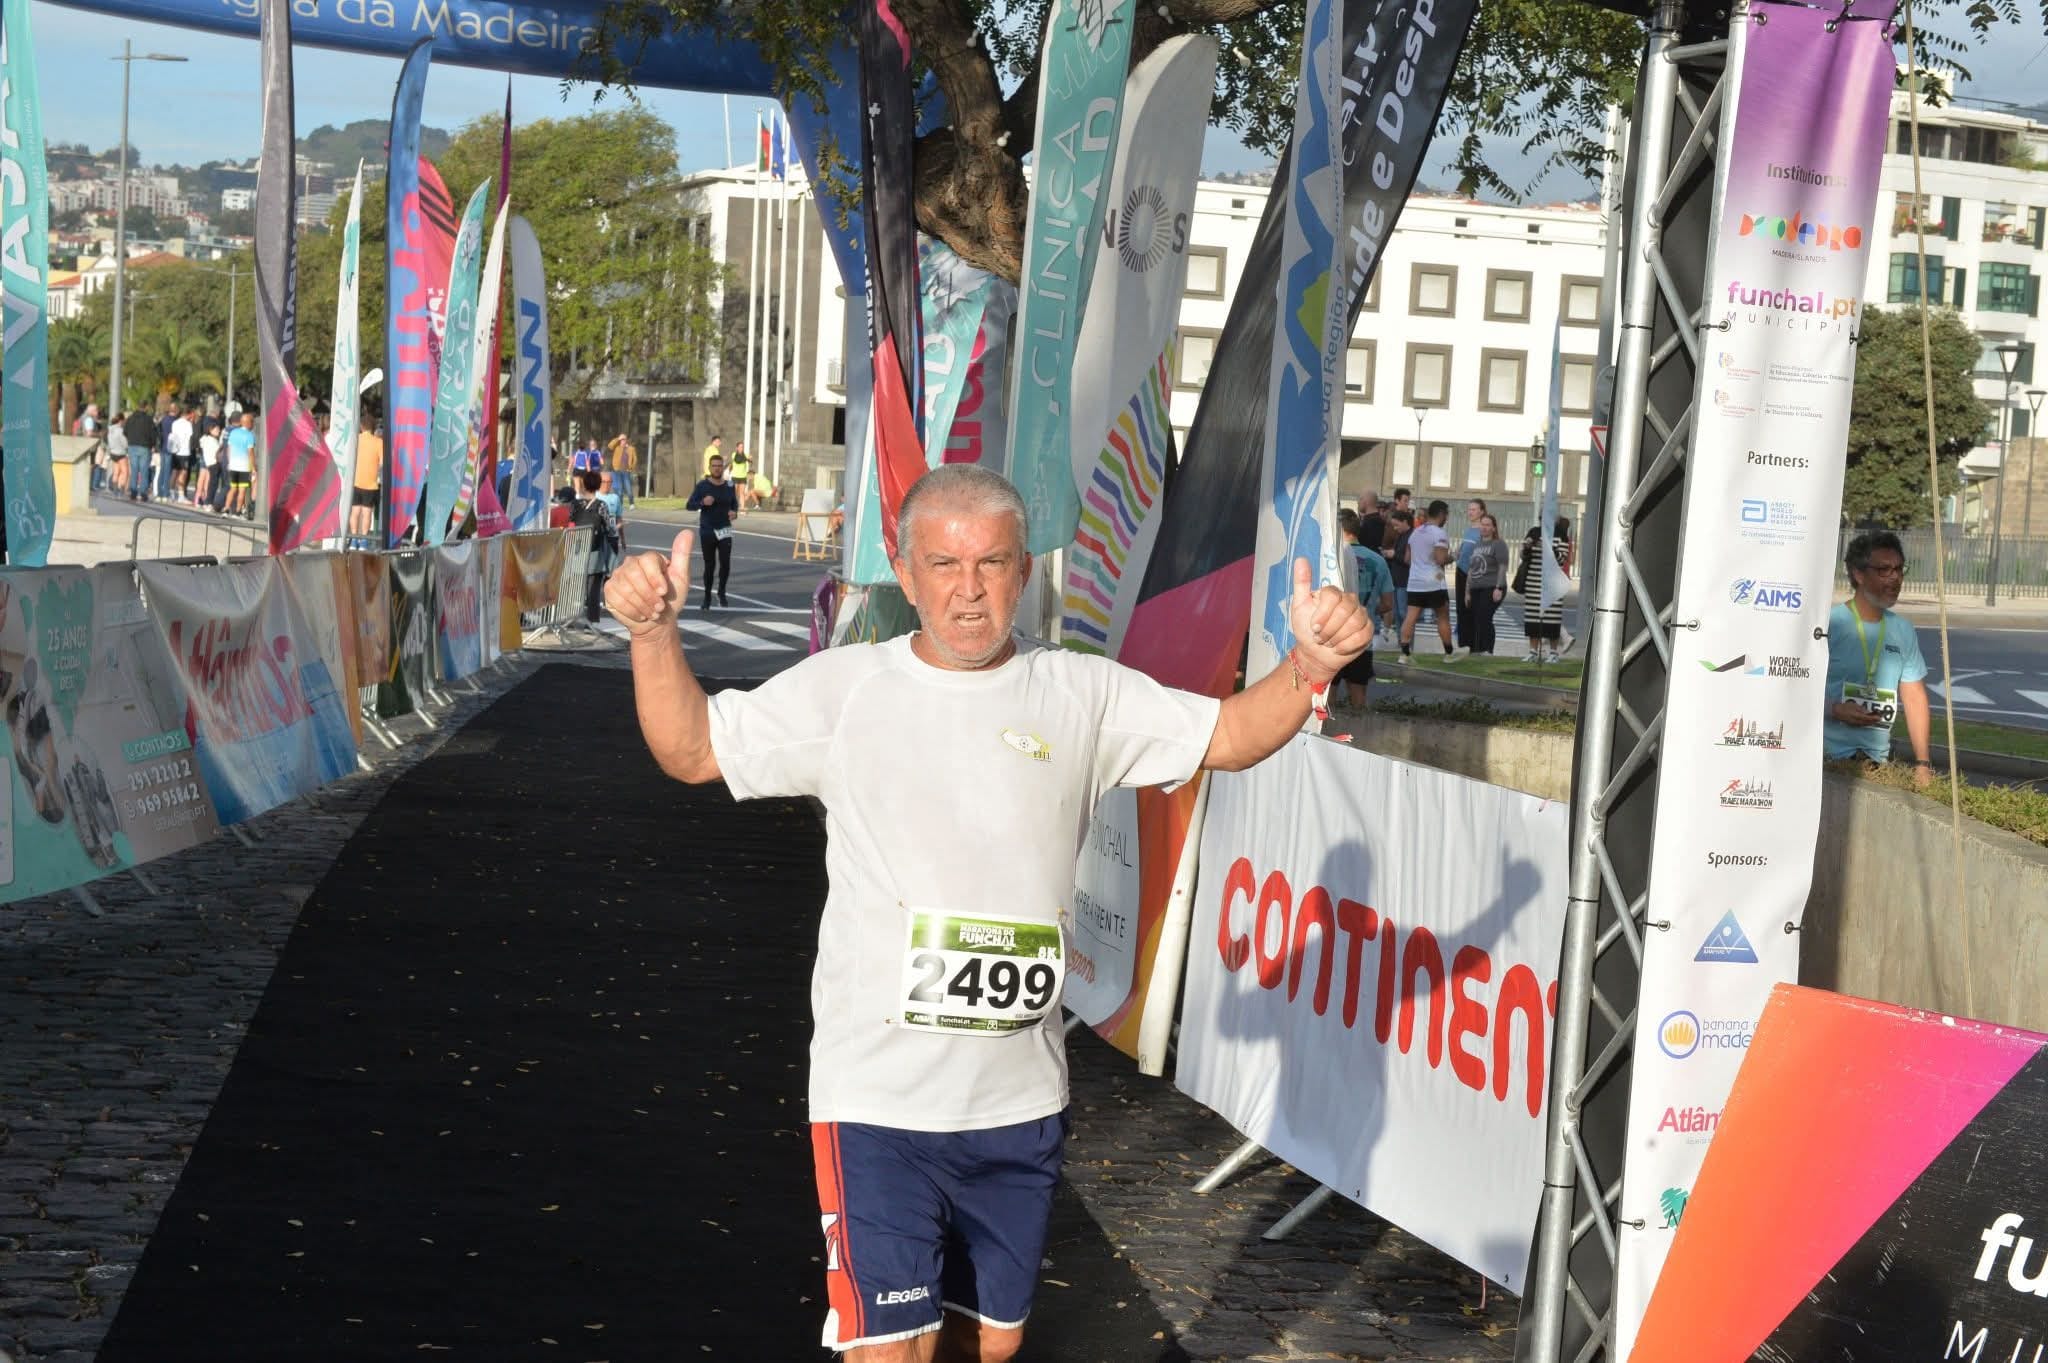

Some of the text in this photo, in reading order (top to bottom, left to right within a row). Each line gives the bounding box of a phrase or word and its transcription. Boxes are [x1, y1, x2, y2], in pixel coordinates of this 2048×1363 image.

[335, 0, 396, 29] da
[410, 0, 602, 55] Madeira
[1371, 151, 1395, 191] e
[1727, 280, 1857, 321] funchal.pt
[1747, 451, 1809, 468] Partners:
[1754, 588, 1802, 609] AIMS
[1769, 655, 1801, 668] WORLD'S
[1768, 667, 1810, 679] MARATHONS
[1707, 851, 1768, 869] Sponsors:
[959, 931, 1016, 947] FUNCHAL
[908, 953, 1056, 1011] 2499
[876, 1285, 930, 1306] LEGEA
